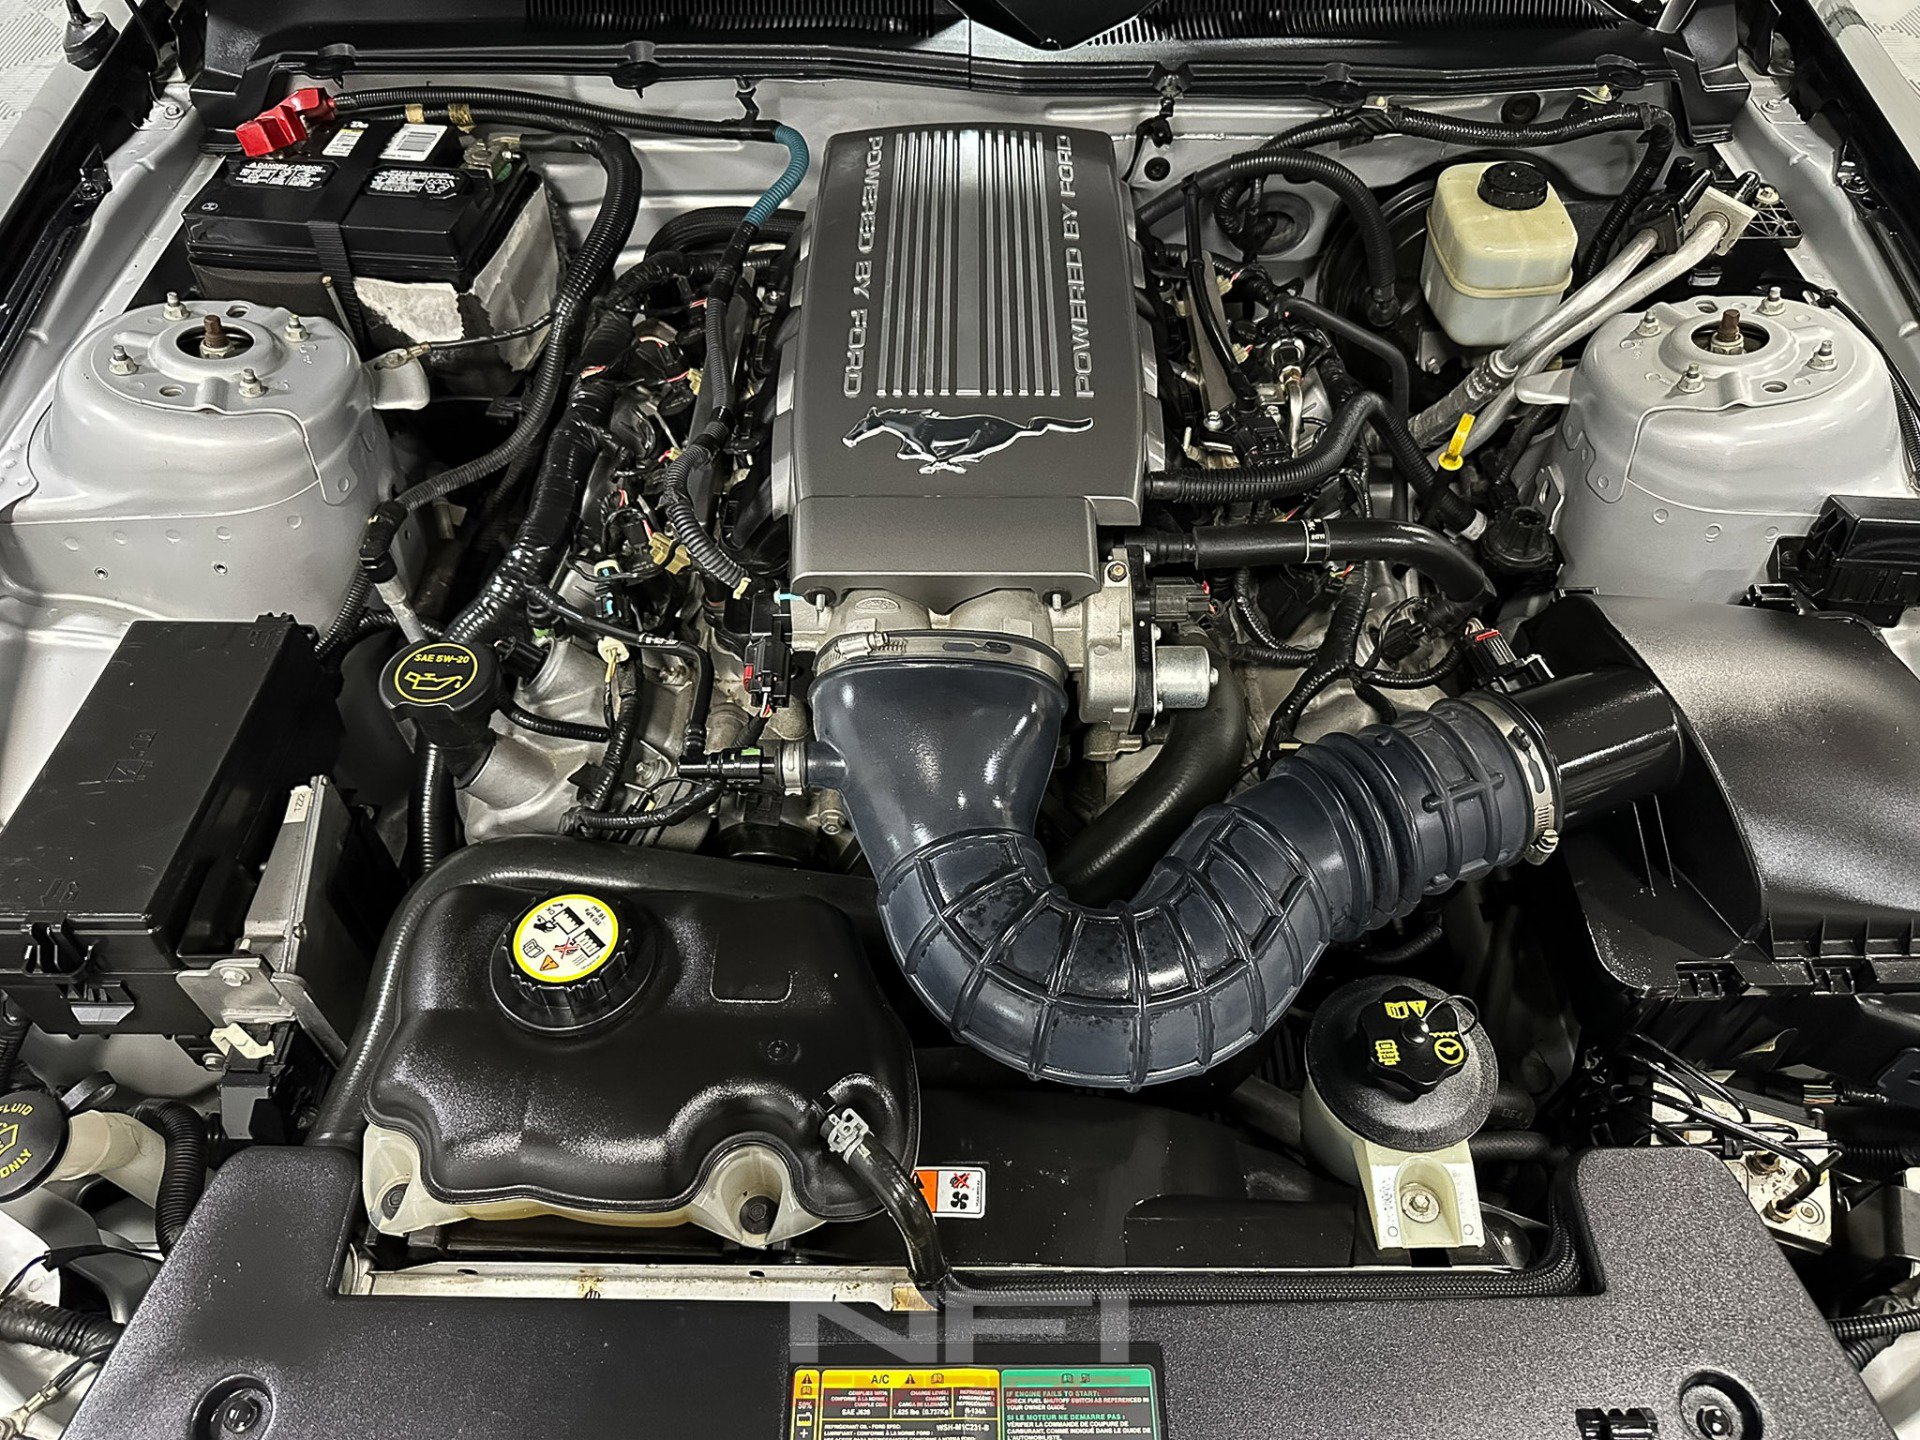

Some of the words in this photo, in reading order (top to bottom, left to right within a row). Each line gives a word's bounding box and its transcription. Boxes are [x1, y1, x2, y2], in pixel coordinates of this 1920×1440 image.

[1056, 135, 1076, 197] FORD
[858, 136, 883, 254] POWERED
[1061, 203, 1080, 239] BY
[853, 260, 872, 299] BY
[1066, 247, 1094, 397] POWERED
[844, 309, 868, 398] FORD
[414, 654, 435, 662] SAE
[435, 654, 470, 664] 5W-20
[0, 1148, 32, 1178] ONLY
[871, 1374, 890, 1384] A/C
